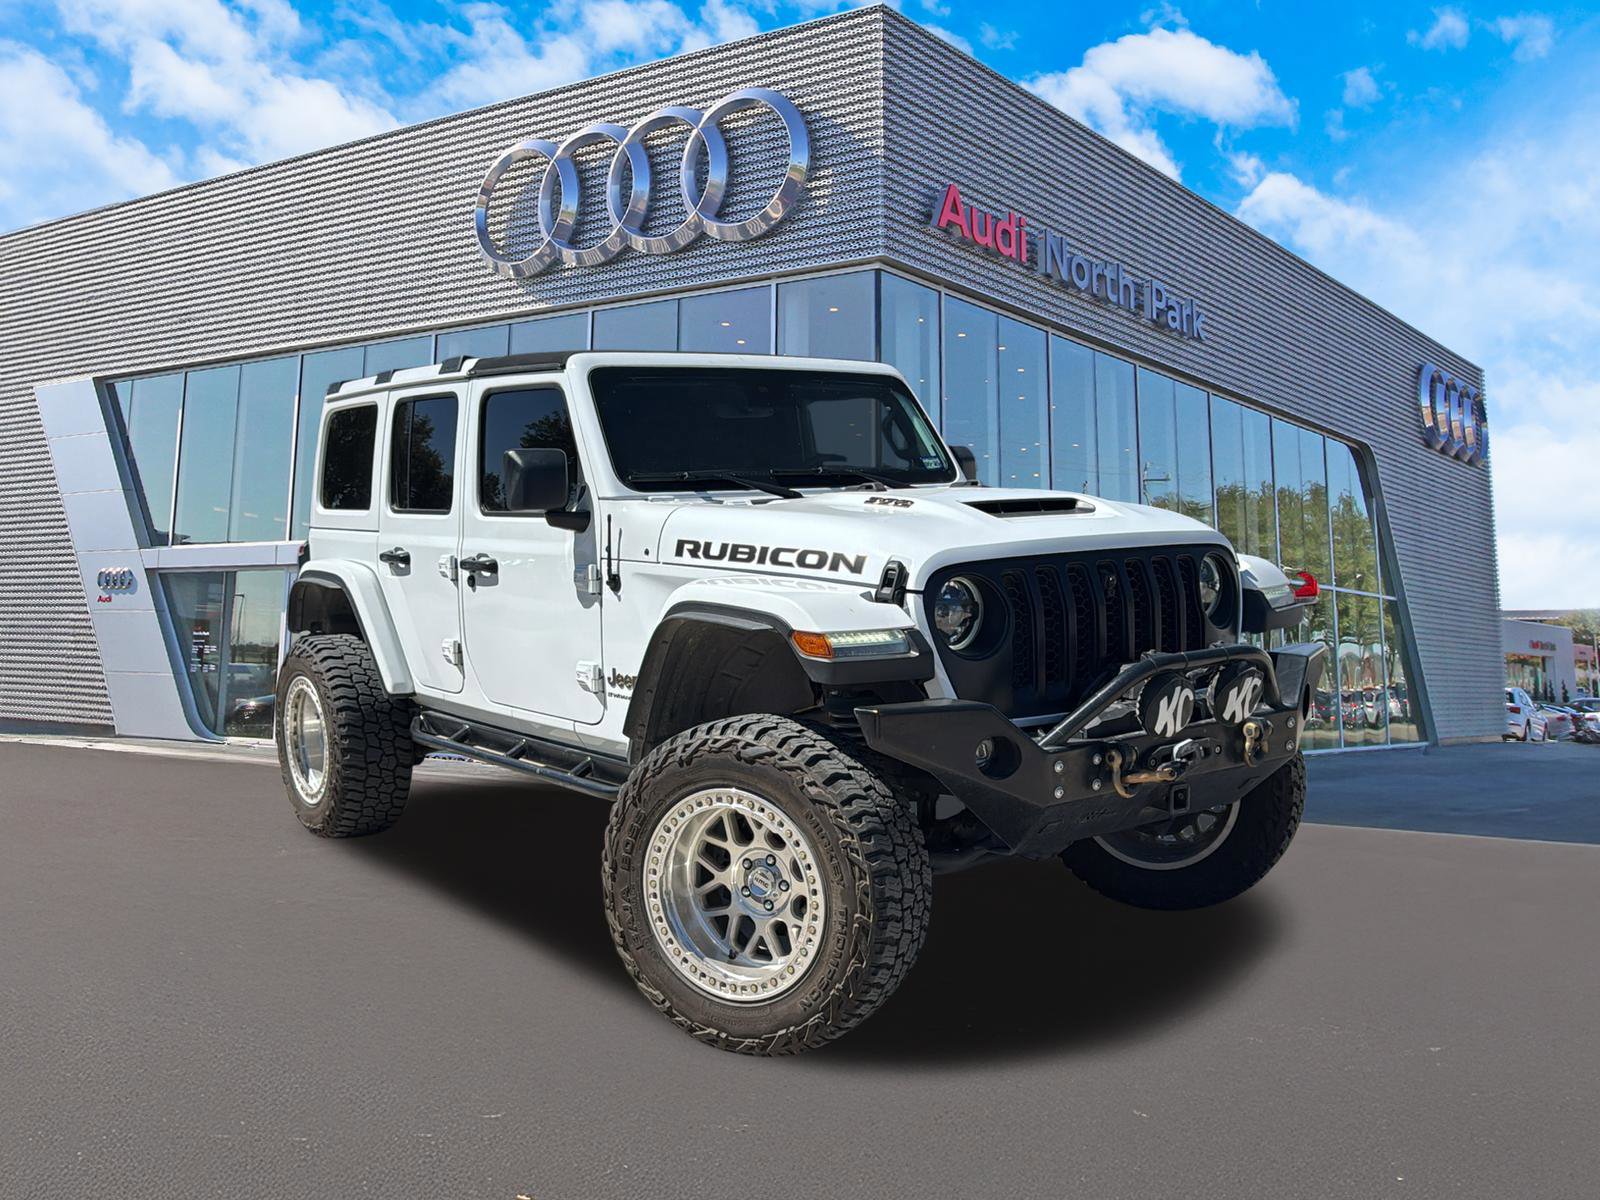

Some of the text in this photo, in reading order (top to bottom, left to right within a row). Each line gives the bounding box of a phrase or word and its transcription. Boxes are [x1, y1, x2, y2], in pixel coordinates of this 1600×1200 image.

[931, 183, 1207, 341] Audi North Park
[674, 538, 868, 575] RUBICON
[97, 594, 113, 603] Audi
[1154, 685, 1195, 738] KC
[1222, 676, 1263, 724] KC
